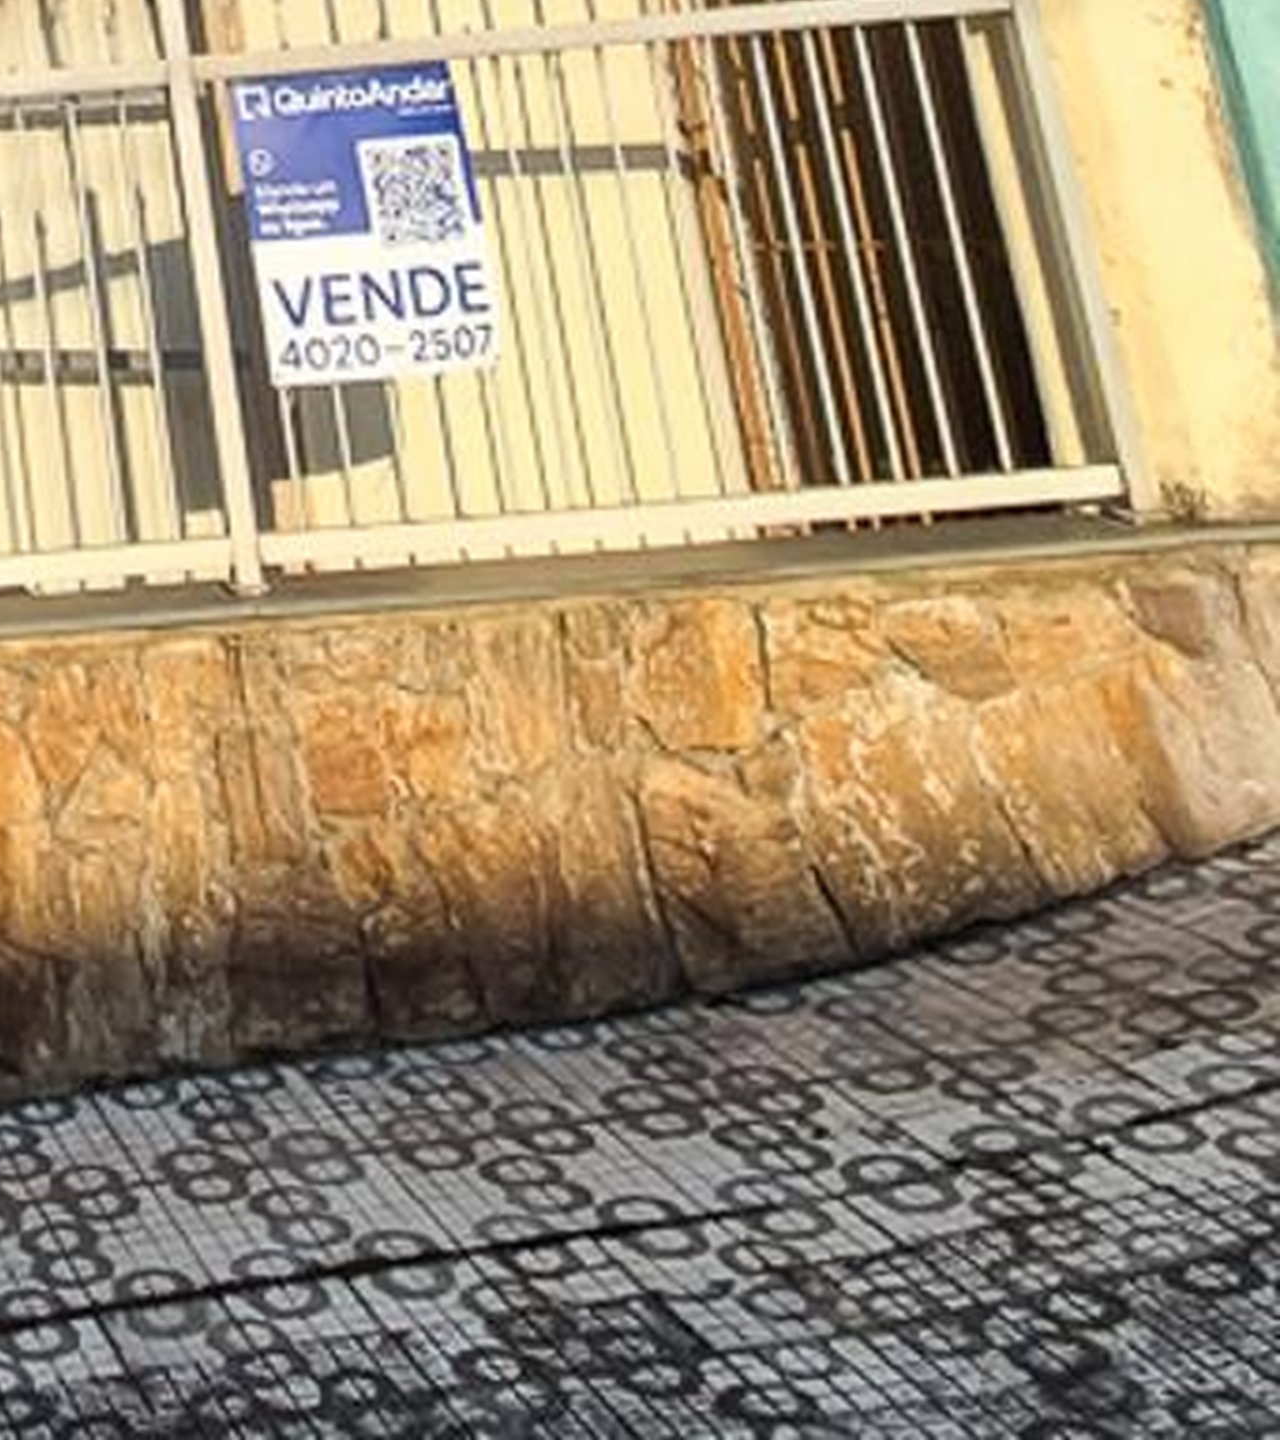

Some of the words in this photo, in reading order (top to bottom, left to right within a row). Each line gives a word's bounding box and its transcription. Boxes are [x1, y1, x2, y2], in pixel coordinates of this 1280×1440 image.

[273, 74, 448, 117] QuintoAndar
[271, 260, 491, 328] VENDE
[278, 324, 494, 371] 4020-2507
